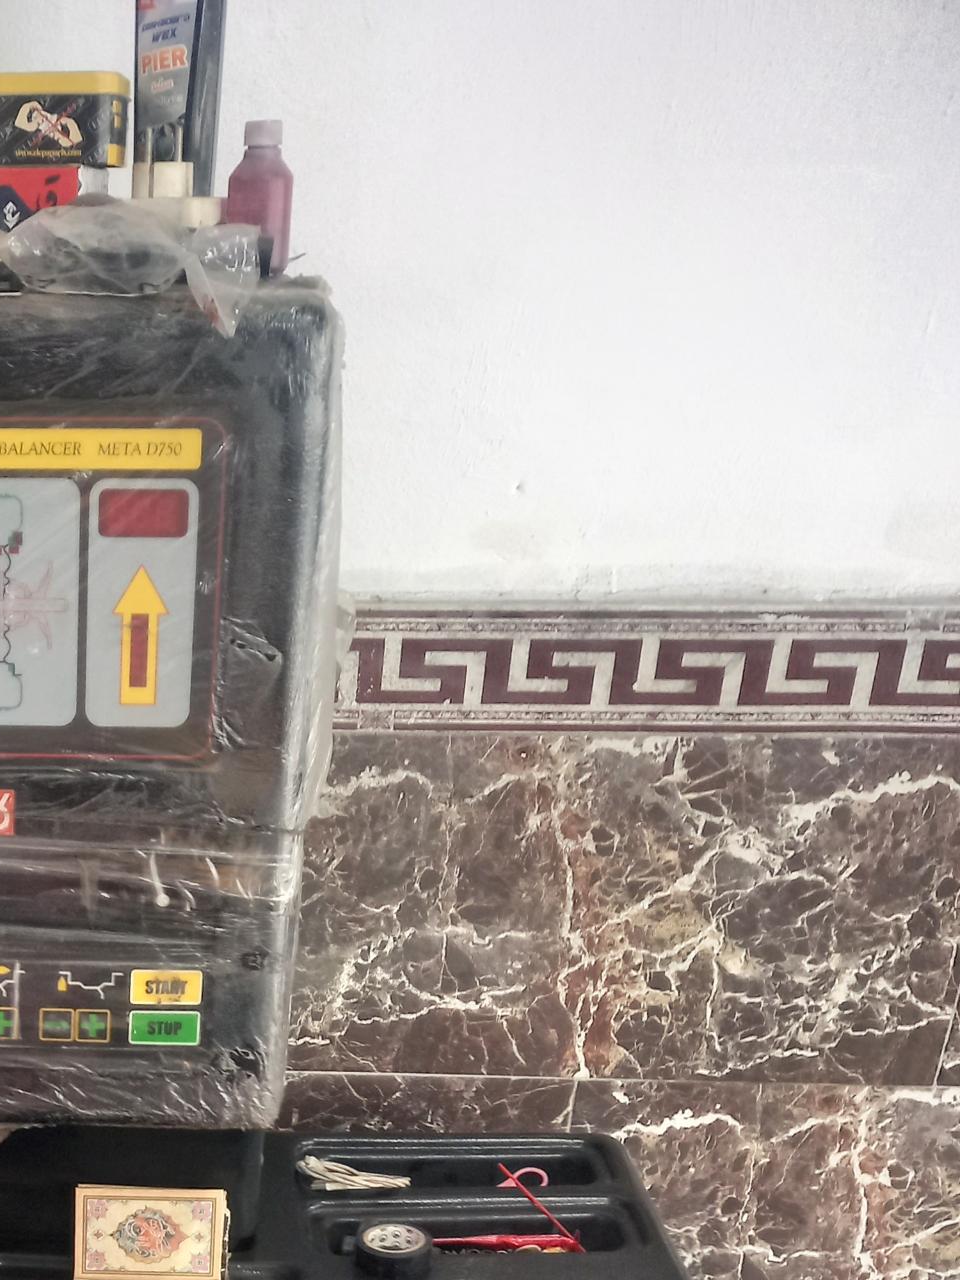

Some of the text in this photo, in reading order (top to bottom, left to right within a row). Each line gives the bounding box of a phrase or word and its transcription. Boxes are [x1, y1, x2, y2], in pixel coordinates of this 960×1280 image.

[141, 44, 188, 75] PIER
[97, 442, 141, 457] META
[145, 442, 182, 457] D750
[145, 978, 188, 995] START
[147, 1020, 182, 1036] STOP
